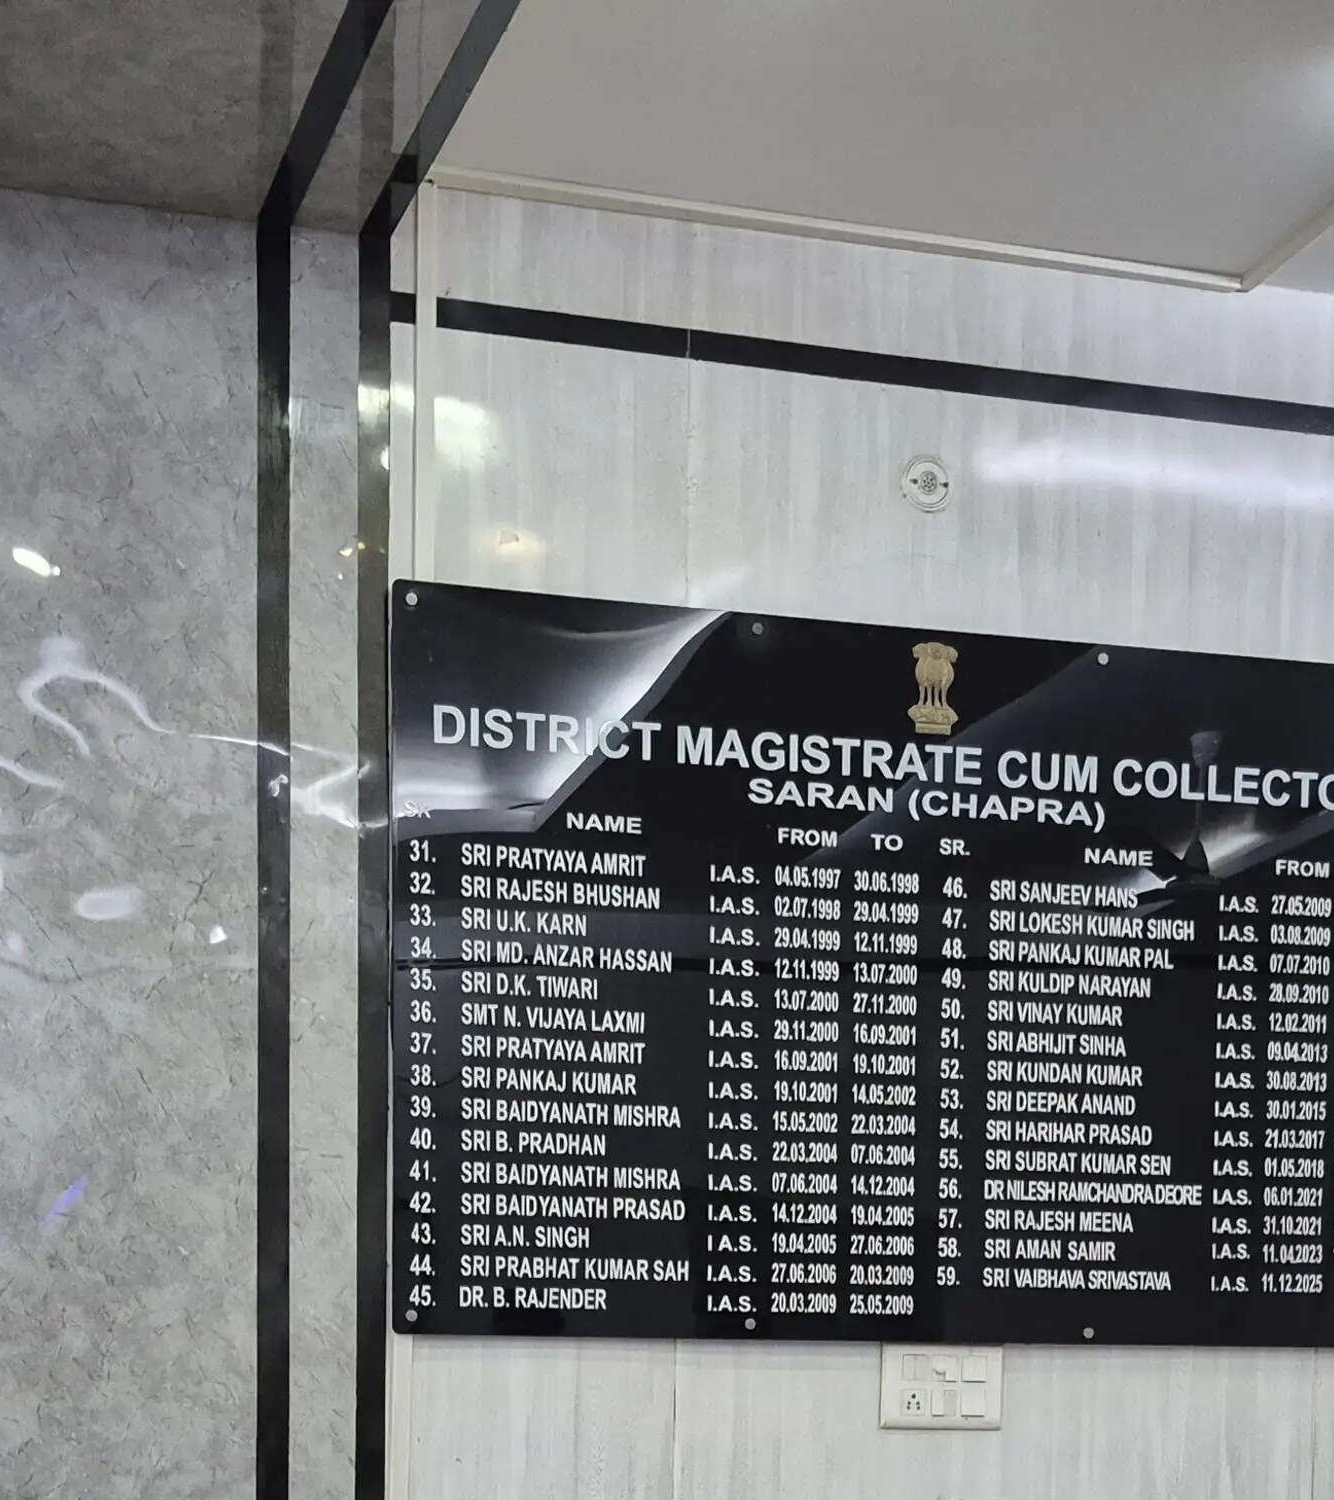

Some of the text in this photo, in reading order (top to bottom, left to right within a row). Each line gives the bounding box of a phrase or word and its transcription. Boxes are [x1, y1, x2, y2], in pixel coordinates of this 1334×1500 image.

[432, 704, 662, 761] DISTRICT
[676, 725, 983, 786] MAGISTRATE
[996, 750, 1099, 794] CUM
[747, 778, 1106, 833] SARAN (CHAPRA)
[409, 839, 919, 893] 31. SRI PRATYAYA AMRIT I.A.S. 04.05.1997 30.06.1998
[566, 812, 643, 835] NAME
[777, 827, 838, 848] FROM
[870, 833, 904, 851] TO
[939, 838, 971, 856] SR.
[1084, 848, 1154, 868] NAME
[1275, 859, 1330, 879] FROM
[409, 871, 918, 924] 32. SRI RAJESH BHUSHAN I.A.S. 02.07.1998 29.04.1999
[942, 876, 967, 898] 46.
[989, 879, 1015, 900] SRI
[1019, 880, 1091, 905] SANJEEV
[1094, 885, 1137, 908] HANS
[1219, 894, 1258, 913] I.A.S.
[1271, 894, 1331, 917] 27.05.2009
[941, 906, 966, 929] 47.
[989, 909, 1015, 931] SRI
[1019, 911, 1082, 934] LOKESH
[1087, 915, 1142, 938] KUMAR
[1146, 918, 1194, 941] SINGH
[1218, 924, 1258, 942] I.A.S.
[1270, 923, 1330, 946] 03.08.2009
[410, 936, 917, 985] 34. SRI MD. ANZAR HASSAN I.A.S. 12.11.1999 13.07.2000
[410, 967, 917, 1015] 35. SRI D.K. TIWARI I.A.S. 13.07.2000 27.11.2000
[941, 967, 965, 989] 49.
[987, 969, 1013, 991] SRI
[1018, 971, 1074, 994] KULDIP
[1078, 974, 1150, 998] NARAYAN
[1216, 982, 1256, 1001] I.A.S.
[1268, 982, 1329, 1004] 28.09.2010
[410, 999, 916, 1045] 36. SMT N. VIJAYA LAXMI I.A.S. 29.11.2000 16.09.2001
[940, 997, 964, 1019] 50.
[987, 999, 1013, 1021] SRI
[1017, 1002, 1063, 1024] VINAY
[1066, 1003, 1122, 1026] KUMAR
[1216, 1012, 1255, 1030] I.A.S.
[1268, 1012, 1326, 1033] 12.02.2011
[940, 1027, 964, 1049] 51.
[986, 1029, 1013, 1051] SRI
[1016, 1031, 1076, 1054] ABHIJIT
[1079, 1034, 1126, 1056] SINHA
[1215, 1042, 1255, 1060] I.A.S.
[1267, 1040, 1327, 1063] 09.04.2013
[410, 1063, 916, 1105] 38. SRI PANKAJ KUMAR I.A.S. 19.10.2001 14.05.2002
[939, 1087, 963, 1109] 53.
[985, 1089, 1011, 1111] SRI
[1016, 1091, 1078, 1113] DEEPAK
[1081, 1093, 1135, 1115] ANAND
[1214, 1100, 1253, 1118] I.A.S.
[1266, 1099, 1326, 1120] 30.01.2015
[410, 1094, 915, 1135] 39. SRI BAIDYANATH MISHRA I.A.S. 15.05.2002 22.03.2004
[939, 1118, 962, 1139] 54.
[985, 1118, 1011, 1140] SRI
[1015, 1121, 1085, 1143] HARIHAR
[1088, 1123, 1152, 1145] PRASAD
[1213, 1130, 1253, 1147] I.A.S.
[1264, 1128, 1325, 1149] 21.03.2017
[409, 1159, 914, 1196] 41. SRI BAIDYANATH MISHRA I.A.S. 07.06.2004 14.12.2004
[936, 1265, 959, 1286] 59.
[982, 1266, 1009, 1287] SRI
[1013, 1268, 1085, 1289] VAIBHAVA
[1087, 1270, 1171, 1290] SRIVASTAVA
[409, 1284, 913, 1315] 45. DR. B. RAJENDER I.A.S. 20.03.2009 25.05.2009
